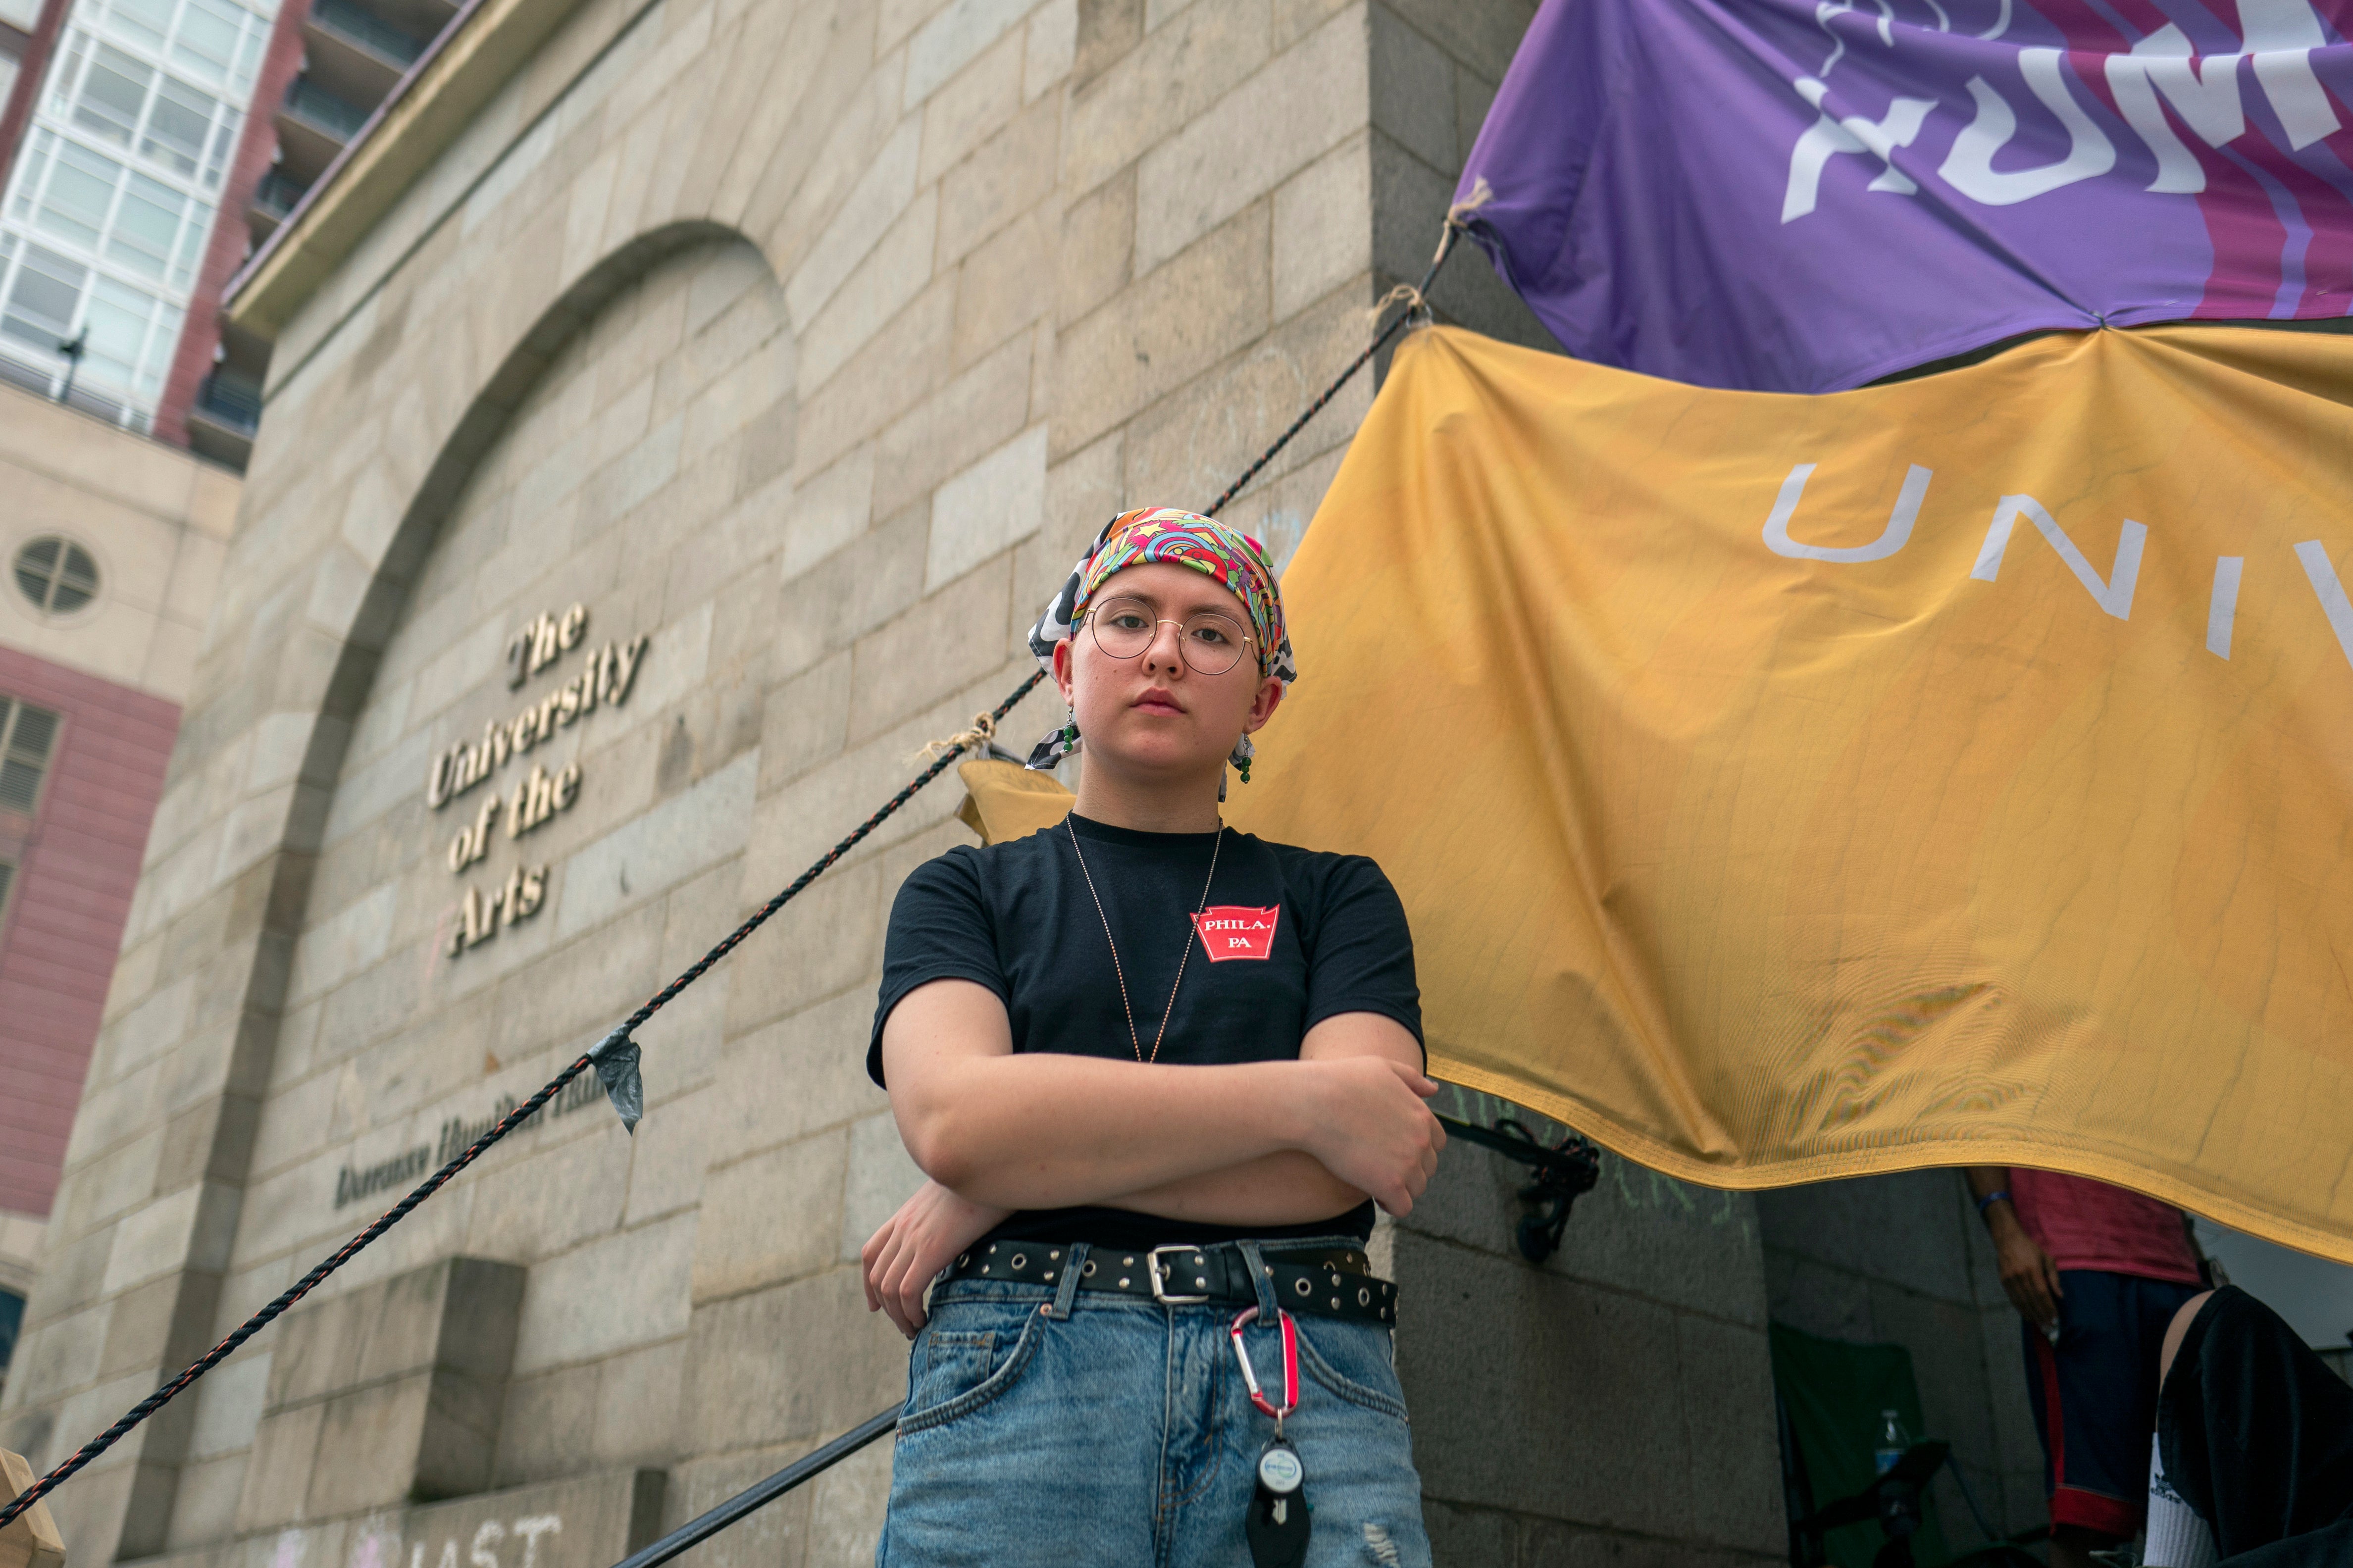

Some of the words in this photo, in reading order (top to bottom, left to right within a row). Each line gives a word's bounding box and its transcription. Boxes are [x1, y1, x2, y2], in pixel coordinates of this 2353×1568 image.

[508, 601, 588, 690] The
[427, 635, 650, 810] University
[447, 794, 501, 873] of
[507, 762, 582, 840] the
[447, 862, 550, 958] Arts
[1205, 920, 1271, 931] PHILA.
[1228, 937, 1252, 948] PA
